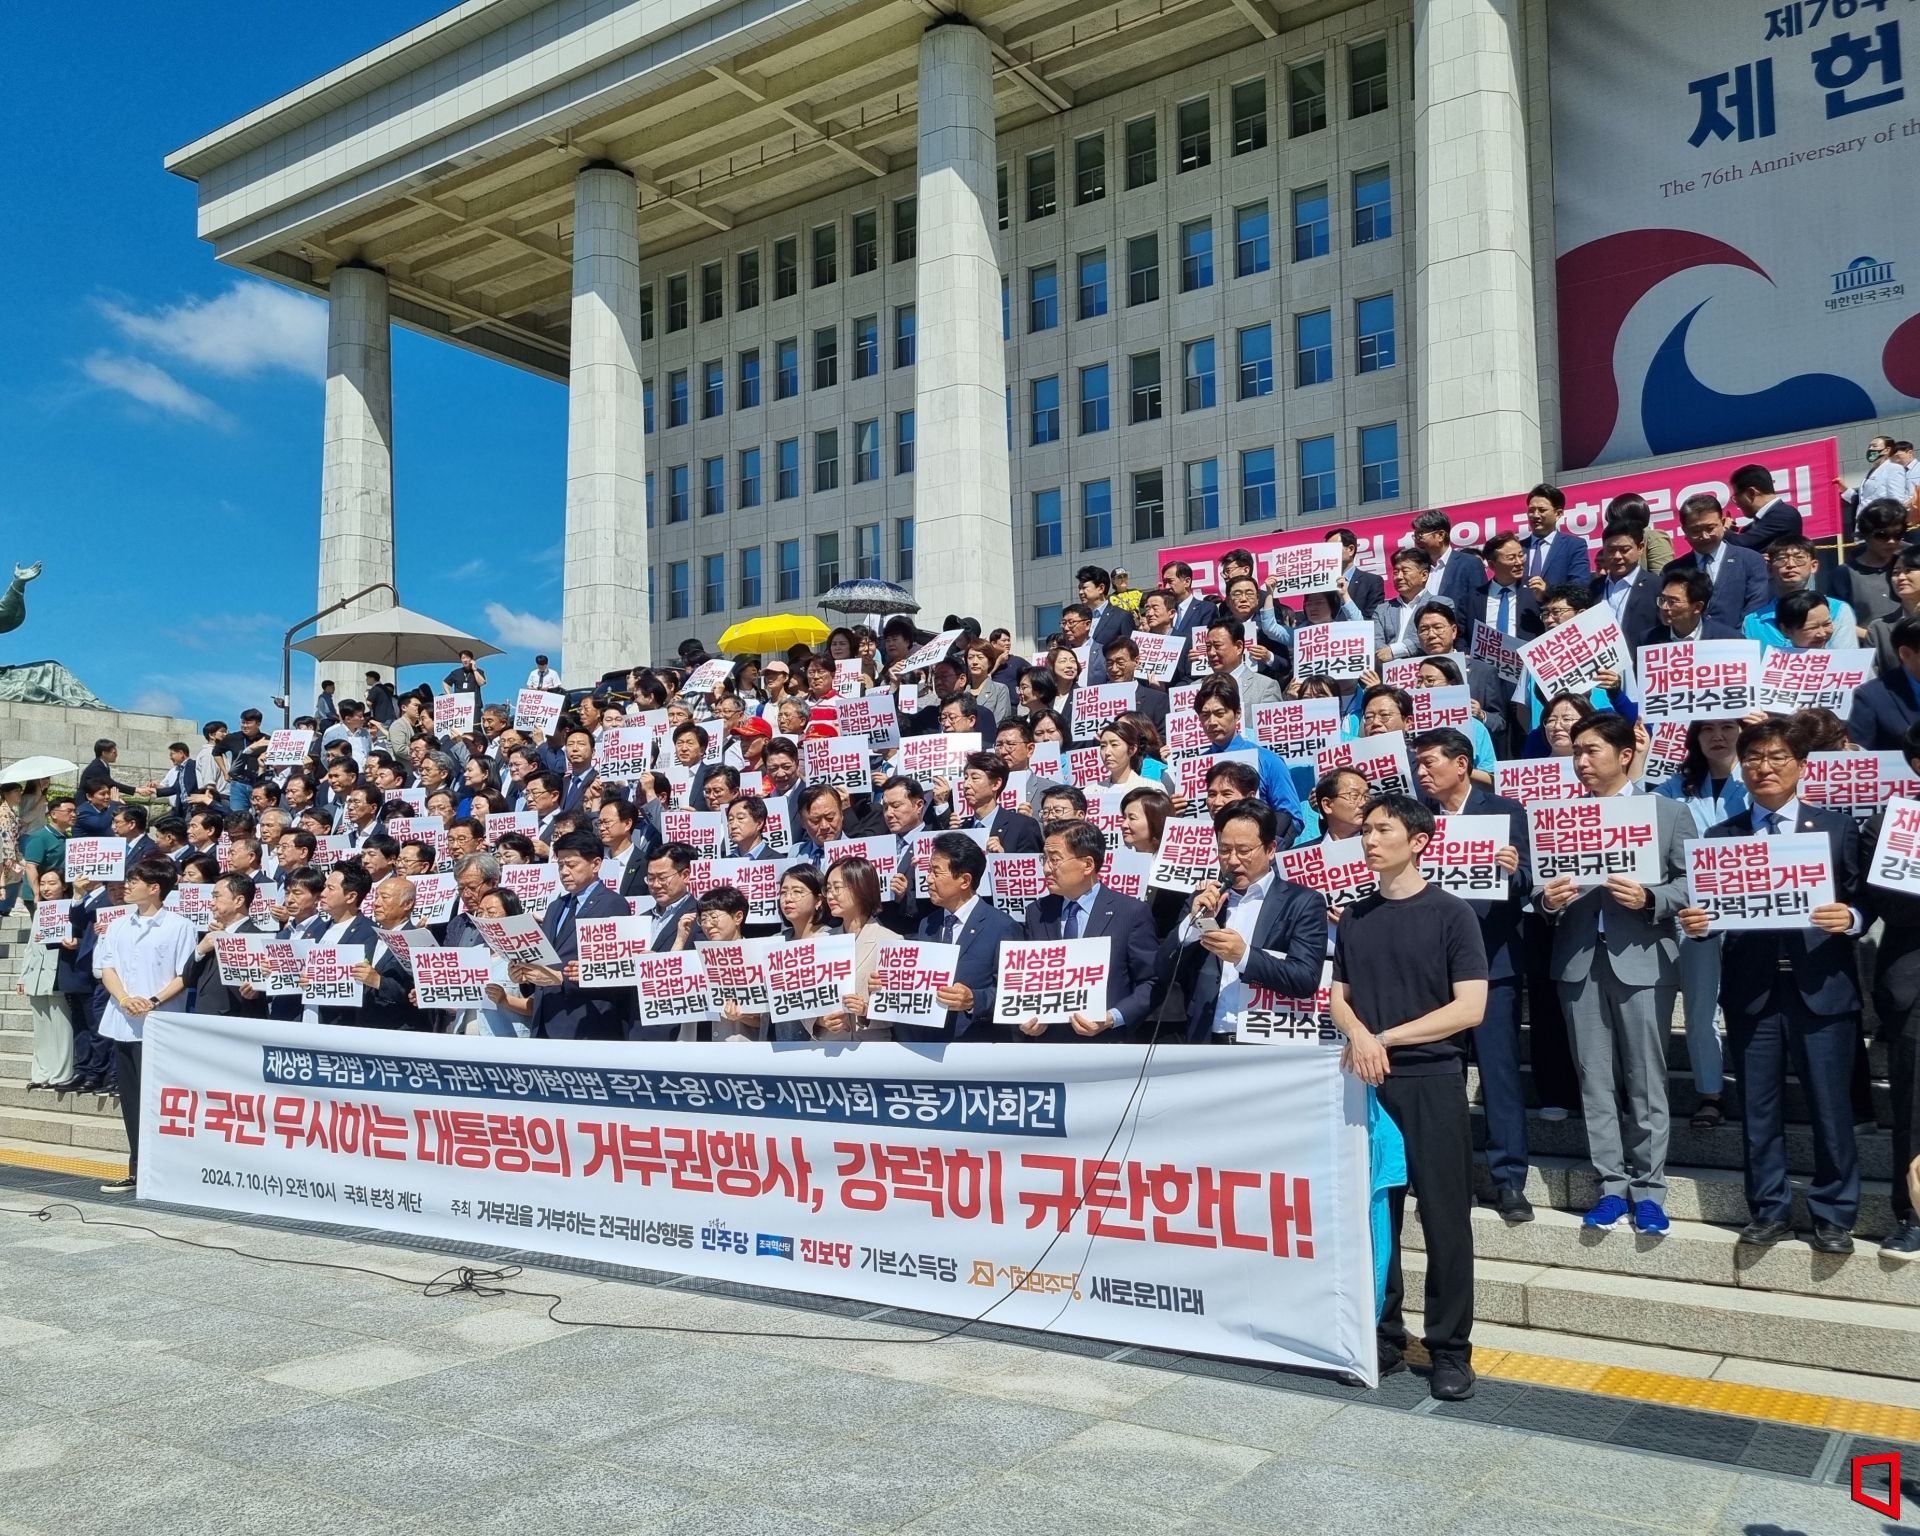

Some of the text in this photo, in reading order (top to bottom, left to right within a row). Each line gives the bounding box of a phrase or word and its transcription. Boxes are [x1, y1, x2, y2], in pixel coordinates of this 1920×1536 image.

[1660, 180, 1695, 198] The
[1701, 165, 1743, 189] 76th
[1750, 136, 1867, 176] Anniversary
[1874, 123, 1897, 143] of
[1275, 558, 1339, 578] 특검법거부
[1276, 548, 1313, 566] 채상병
[1275, 572, 1329, 593] 강력규탄!
[1299, 625, 1329, 647] 민생
[1477, 624, 1503, 648] 민생
[1527, 623, 1583, 667] 채상병
[1299, 638, 1365, 663] 개혁입법
[1536, 623, 1620, 682] 특검법거부
[1645, 643, 1694, 672] 민생
[1298, 654, 1370, 678] 즉각수용!
[1768, 652, 1831, 672] 채상병
[1645, 662, 1747, 695] 개혁입법
[1761, 671, 1864, 691] 특검법거부
[435, 697, 455, 710] 채상병
[519, 694, 543, 705] 채상병
[1076, 687, 1099, 706] 민생
[1645, 686, 1756, 716] 즉각수용!
[1759, 688, 1844, 710] 강력규탄!
[435, 706, 473, 721] 특검법거부
[517, 704, 558, 717] 특검법거부
[838, 701, 869, 716] 채상병
[1075, 699, 1128, 721] 개혁입법
[1256, 704, 1304, 726] 채상병
[840, 713, 895, 732] 특검법거부
[1258, 718, 1337, 743] 특검법거부
[601, 742, 644, 762] 개혁입법
[806, 740, 829, 759] 민생
[903, 737, 948, 756] 채상병
[600, 757, 647, 778] 즉각수용!
[808, 753, 861, 776] 개혁입법
[1070, 749, 1099, 770] 민생
[1317, 744, 1353, 773] 민생
[1804, 757, 1879, 782] 채상병
[1500, 763, 1560, 787] 채상병
[390, 819, 411, 834] 민생
[487, 816, 516, 832] 채상병
[665, 814, 691, 831] 민생
[1533, 803, 1601, 830] 채상병
[1166, 825, 1216, 845] 채상병
[1535, 824, 1653, 854] 특검법거부
[69, 840, 99, 854] 채상병
[1692, 842, 1769, 871] 채상병
[68, 852, 123, 865] 특검법거부
[994, 856, 1036, 879] 채상병
[1282, 847, 1325, 878] 민생
[1537, 850, 1636, 878] 강력규탄!
[67, 863, 113, 878] 강력규탄!
[505, 868, 541, 884] 채상병
[737, 864, 775, 883] 채상병
[1694, 863, 1827, 895] 특검법거부
[1697, 891, 1810, 921] 강력규탄!
[579, 922, 617, 943] 채상병
[215, 937, 246, 952] 채상병
[265, 944, 294, 959] 채상병
[580, 939, 646, 962] 특검법거부
[308, 949, 337, 964] 채상병
[416, 951, 459, 969] 채상병
[701, 946, 744, 966] 채상병
[768, 944, 815, 968] 채상병
[878, 947, 919, 968] 채상병
[1004, 946, 1067, 971] 채상병
[418, 968, 490, 986] 특검법거부
[581, 959, 635, 982] 강력규탄
[640, 956, 683, 979] 채상병
[769, 960, 851, 992] 특검법거부
[877, 969, 950, 991] 특검법거부
[1003, 965, 1104, 993] 특검법거부
[305, 982, 354, 1000] 강력규탄!
[420, 986, 484, 1003] 강력규탄!
[773, 983, 840, 1016] 강력규탄!
[874, 991, 933, 1015] 강력규탄!
[1001, 989, 1088, 1017] 강력규탄!
[266, 1051, 1056, 1129] 채상병 특검법 거부 강력 규탄! 민생개혁입법 즉각 수용! 야당-시민사회 공동기자회견
[159, 1087, 1315, 1260] 또! 국민 무시하는 대통령의 거부권행사, 강력히 규탄한다!
[201, 1168, 423, 1213] 2024.7.10.(수) 오전 10시 국회 본청 계단
[450, 1200, 694, 1249] 주최 거부권을 거부하는 전국비상행동
[701, 1227, 1205, 1316] 민주당 조국혁신당 진보당 기본소득당 사회민주당 새로운미래
